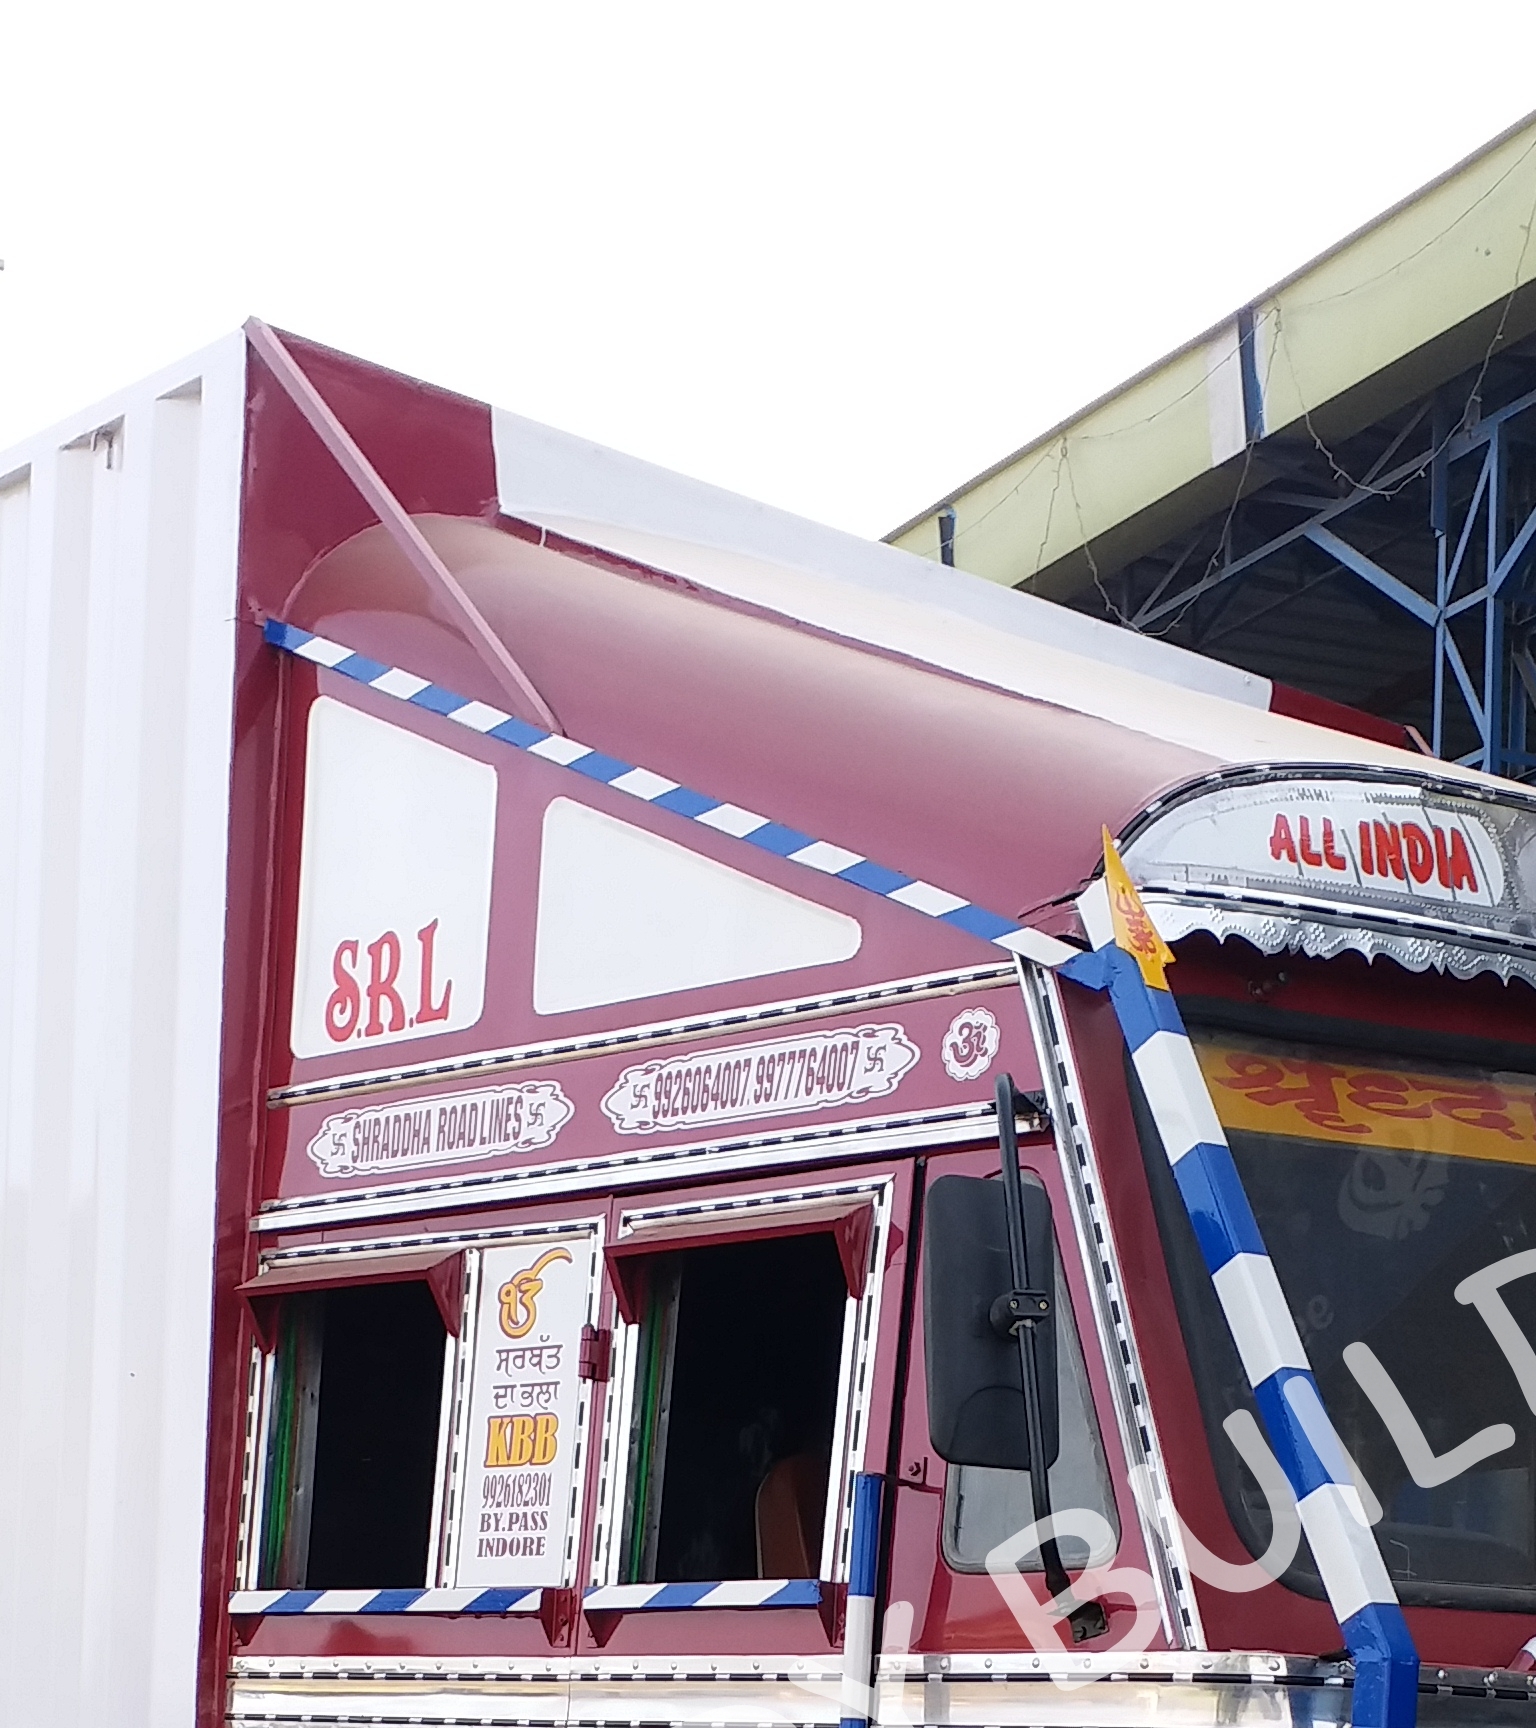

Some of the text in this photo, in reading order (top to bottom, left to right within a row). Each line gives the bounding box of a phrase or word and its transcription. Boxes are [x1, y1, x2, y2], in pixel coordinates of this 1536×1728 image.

[1269, 812, 1479, 894] ALL INDIA
[350, 1109, 432, 1164] SHRADDHA
[483, 1411, 559, 1469] KBB
[481, 1471, 553, 1510] 9926182301
[476, 1535, 546, 1559] INDORE
